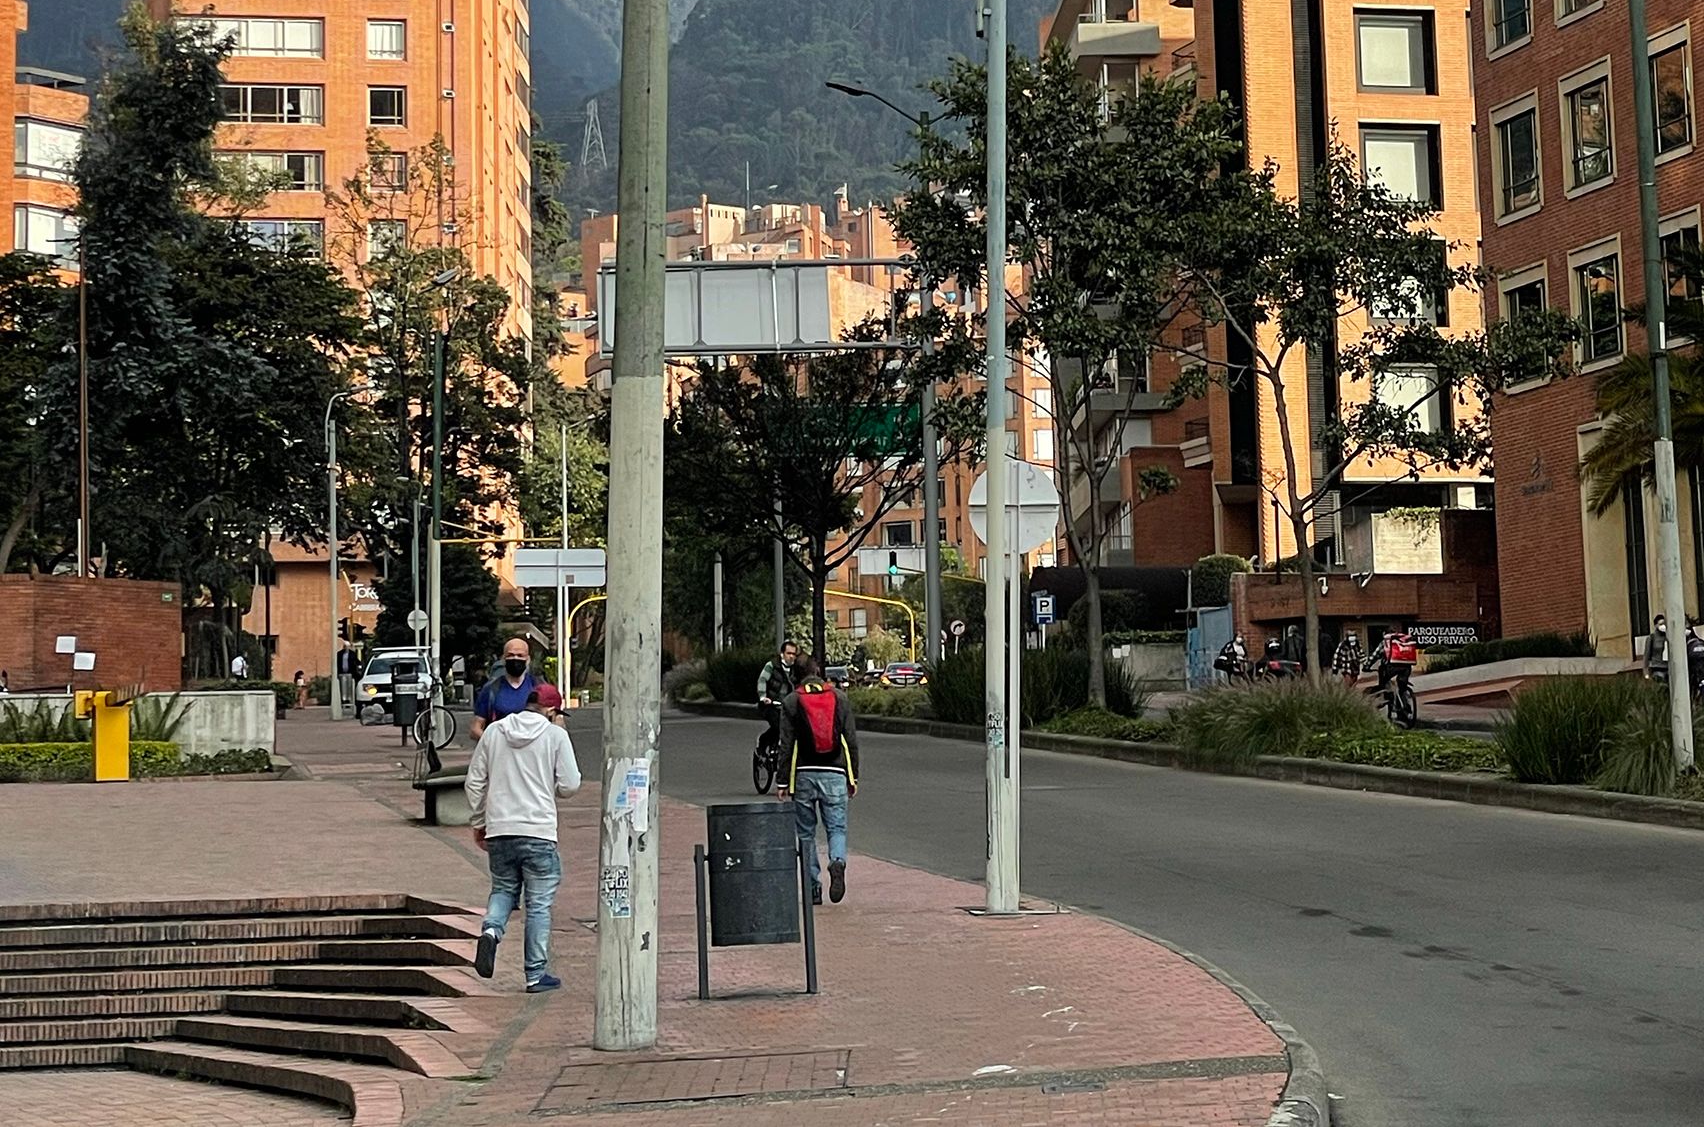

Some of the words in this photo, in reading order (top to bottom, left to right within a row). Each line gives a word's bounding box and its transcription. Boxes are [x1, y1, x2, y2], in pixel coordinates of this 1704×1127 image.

[1040, 600, 1050, 613] P
[1407, 626, 1475, 636] PARQUEADERO
[1417, 636, 1437, 645] USO
[1438, 636, 1479, 645] PRIVADO
